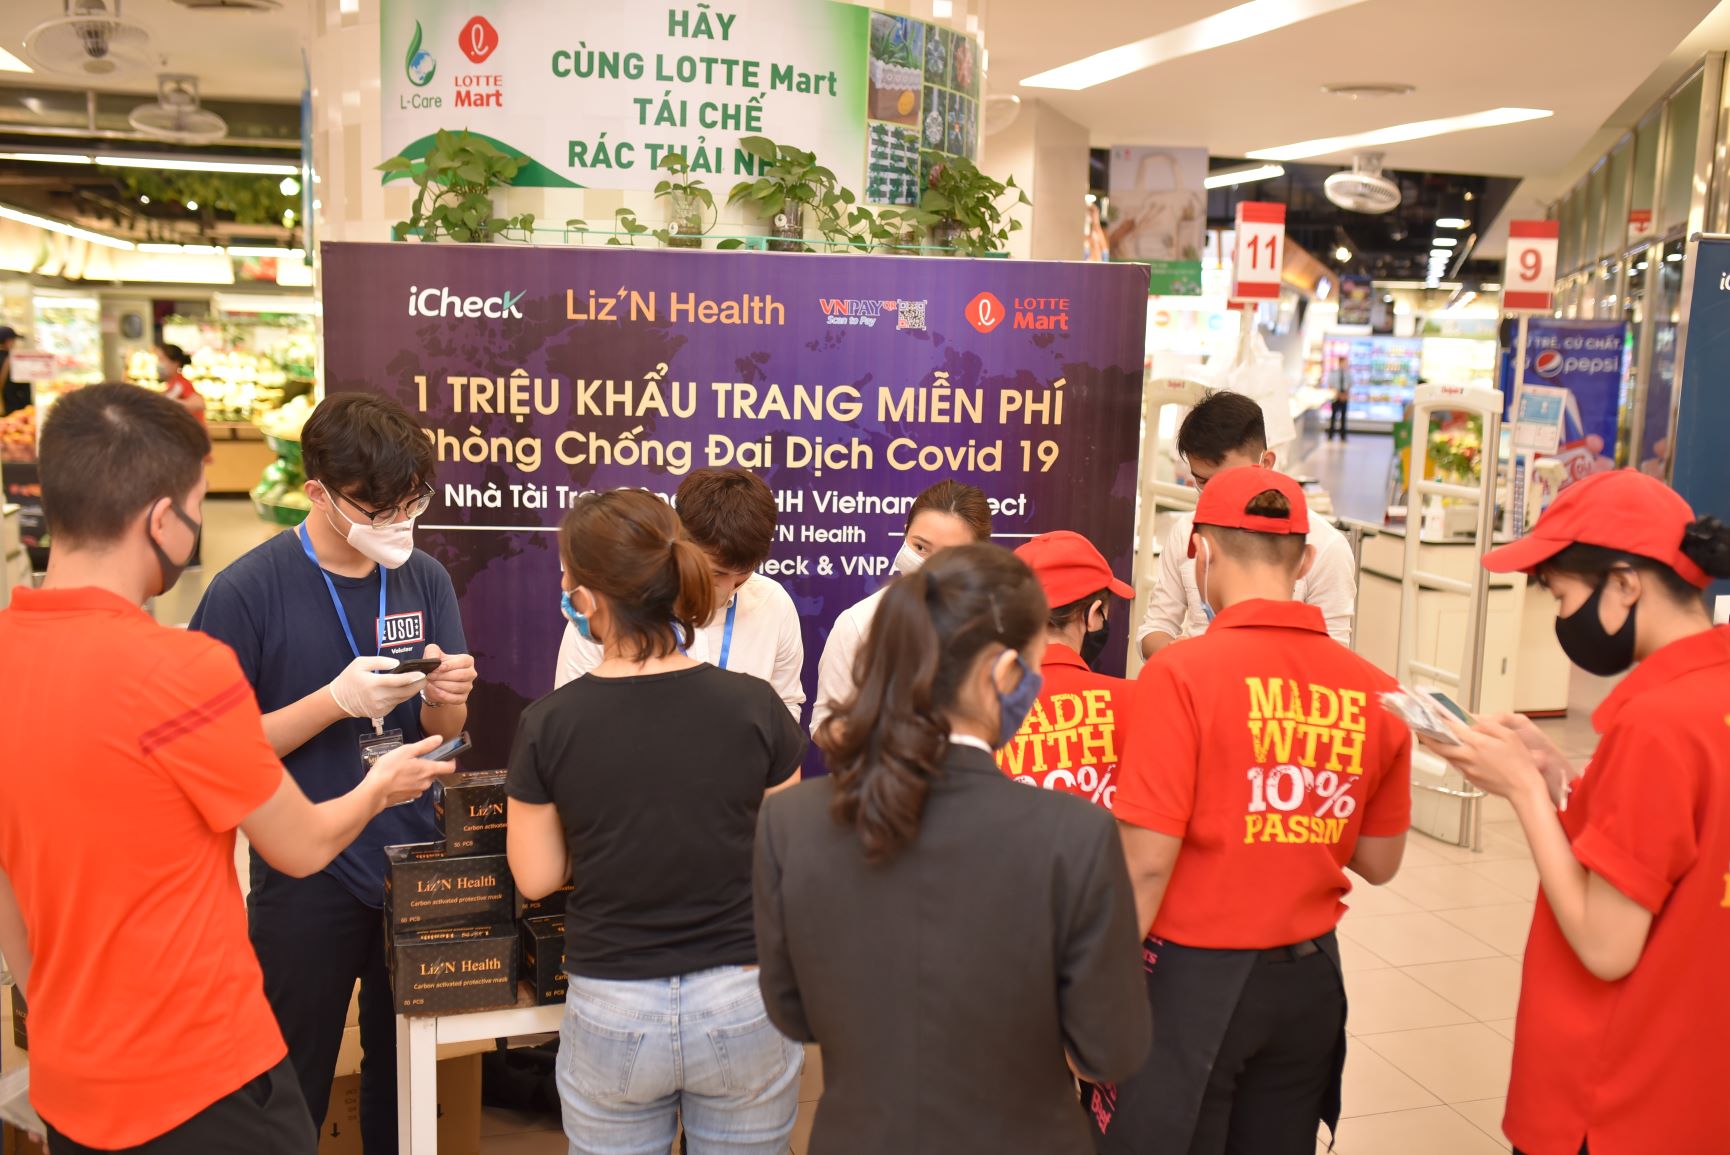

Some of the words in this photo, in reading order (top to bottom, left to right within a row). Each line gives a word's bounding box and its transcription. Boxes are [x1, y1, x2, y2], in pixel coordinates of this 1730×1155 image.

[668, 3, 736, 41] HÃY
[552, 41, 644, 80] CÙNG
[656, 54, 760, 88] LOTTE
[770, 63, 837, 97] Mart
[455, 75, 502, 87] LOTTE
[400, 94, 442, 109] L-Care
[455, 90, 503, 107] Mart
[633, 90, 687, 128] TÁI
[699, 92, 767, 132] CHẾ
[568, 132, 635, 169] RÁC
[644, 135, 722, 174] THẢI
[1247, 234, 1278, 270] 11
[1519, 248, 1543, 282] 9
[408, 286, 527, 319] iCheck
[671, 292, 785, 325] Health
[1014, 298, 1070, 310] LOTTE
[827, 316, 847, 325] Scan
[849, 317, 858, 325] to
[859, 316, 876, 327] Pay
[1013, 312, 1069, 330] Mart
[1563, 356, 1619, 375] pepsi
[414, 376, 428, 412] 1
[447, 368, 559, 423] TRIỆU
[577, 362, 697, 418] KHẨU
[712, 382, 863, 423] TRANG
[878, 371, 983, 425] MIỄN
[999, 378, 1067, 425] PHÍ
[555, 425, 692, 476] Chống
[787, 435, 874, 477] Dịch
[886, 437, 1003, 473] Covid
[1020, 440, 1059, 474] 19
[445, 482, 501, 508] Nhà
[510, 482, 547, 509] Tài
[801, 526, 866, 543] Health
[817, 556, 833, 576] &
[387, 617, 415, 641] USO
[463, 823, 484, 832] Carbon
[457, 875, 496, 889] Health
[410, 899, 432, 908] Carbon
[432, 897, 458, 906] activated
[459, 895, 487, 904] protective
[461, 957, 501, 973] Health
[436, 980, 462, 988] activated
[463, 978, 492, 987] protective
[493, 976, 508, 984] mask
